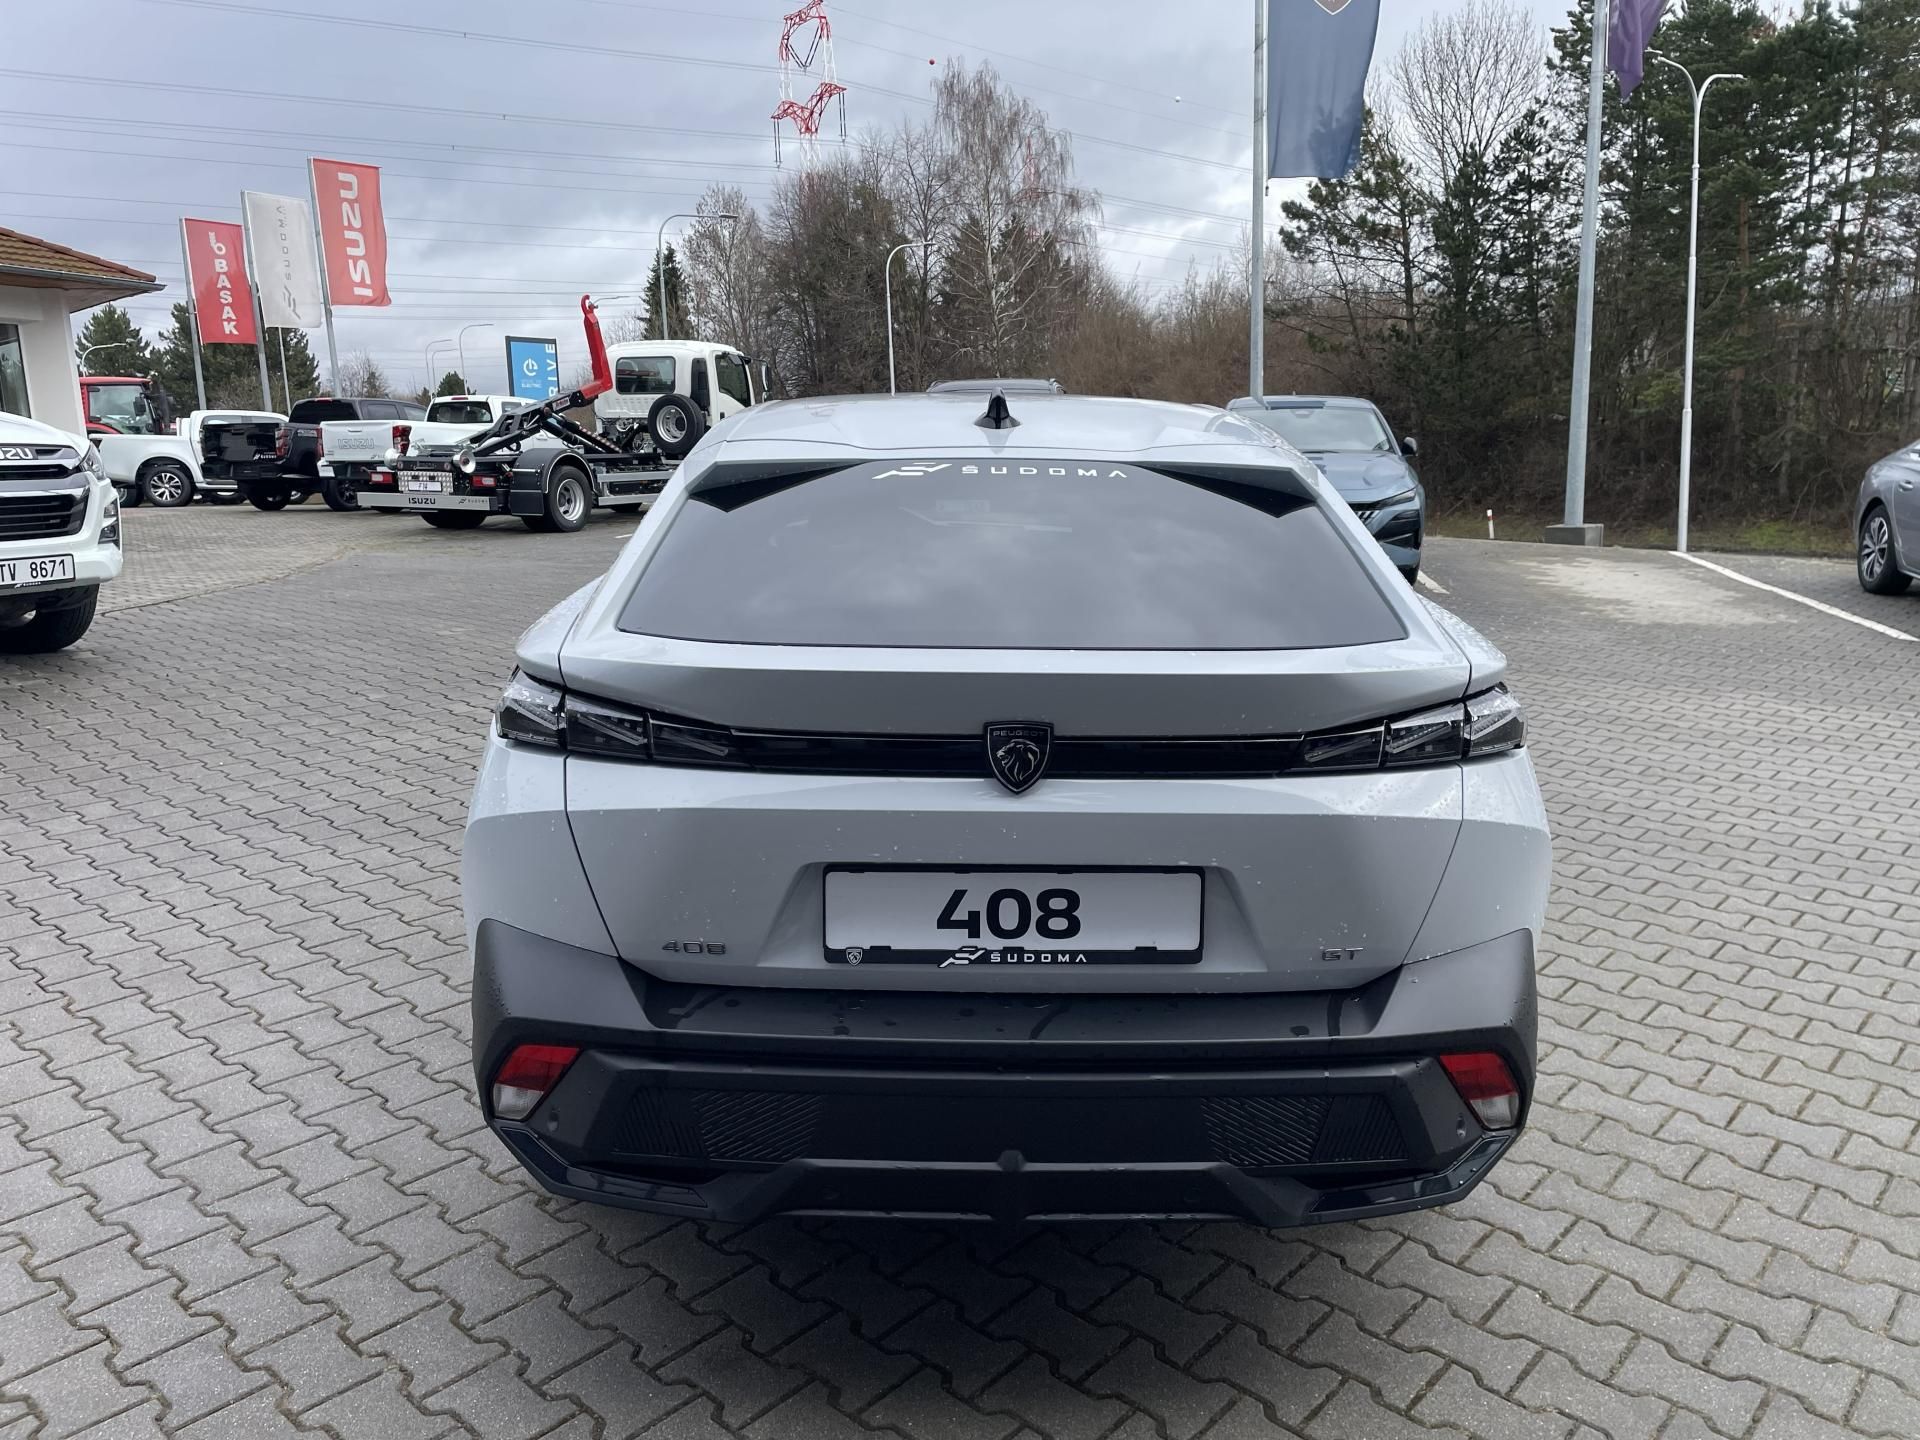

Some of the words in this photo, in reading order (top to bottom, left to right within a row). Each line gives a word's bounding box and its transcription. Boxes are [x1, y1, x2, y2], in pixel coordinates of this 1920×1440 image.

[337, 172, 374, 297] ISUZU
[337, 438, 375, 450] ISUZU
[0, 447, 34, 460] ZU
[408, 497, 436, 505] ISUZU
[29, 559, 66, 579] 8671
[936, 888, 1081, 940] 408
[662, 940, 726, 955] 408
[1321, 947, 1364, 961] GT
